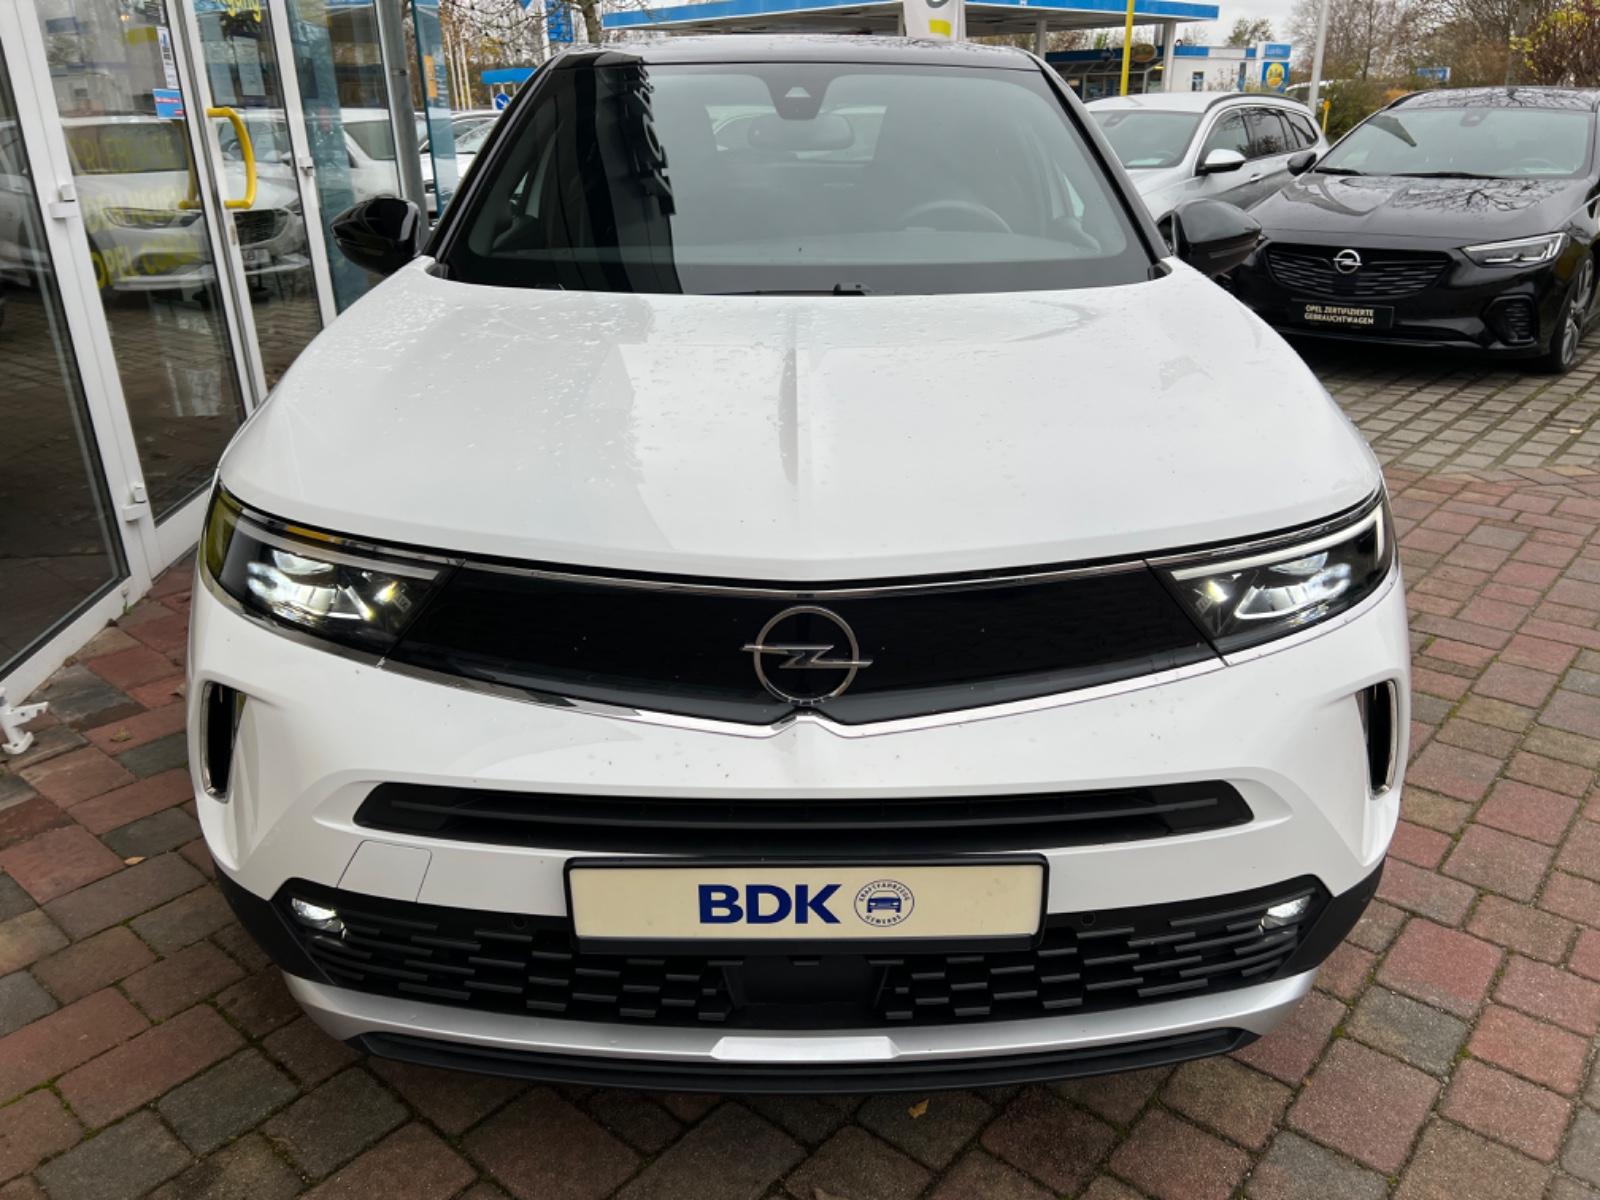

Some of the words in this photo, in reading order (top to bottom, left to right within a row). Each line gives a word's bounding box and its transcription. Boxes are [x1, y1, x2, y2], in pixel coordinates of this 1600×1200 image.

[1305, 304, 1322, 313] OPEL
[1324, 305, 1374, 316] ZERTIFIZIERTE
[1304, 312, 1374, 324] GEBRAUCHTWAGEN
[698, 884, 842, 924] BDK
